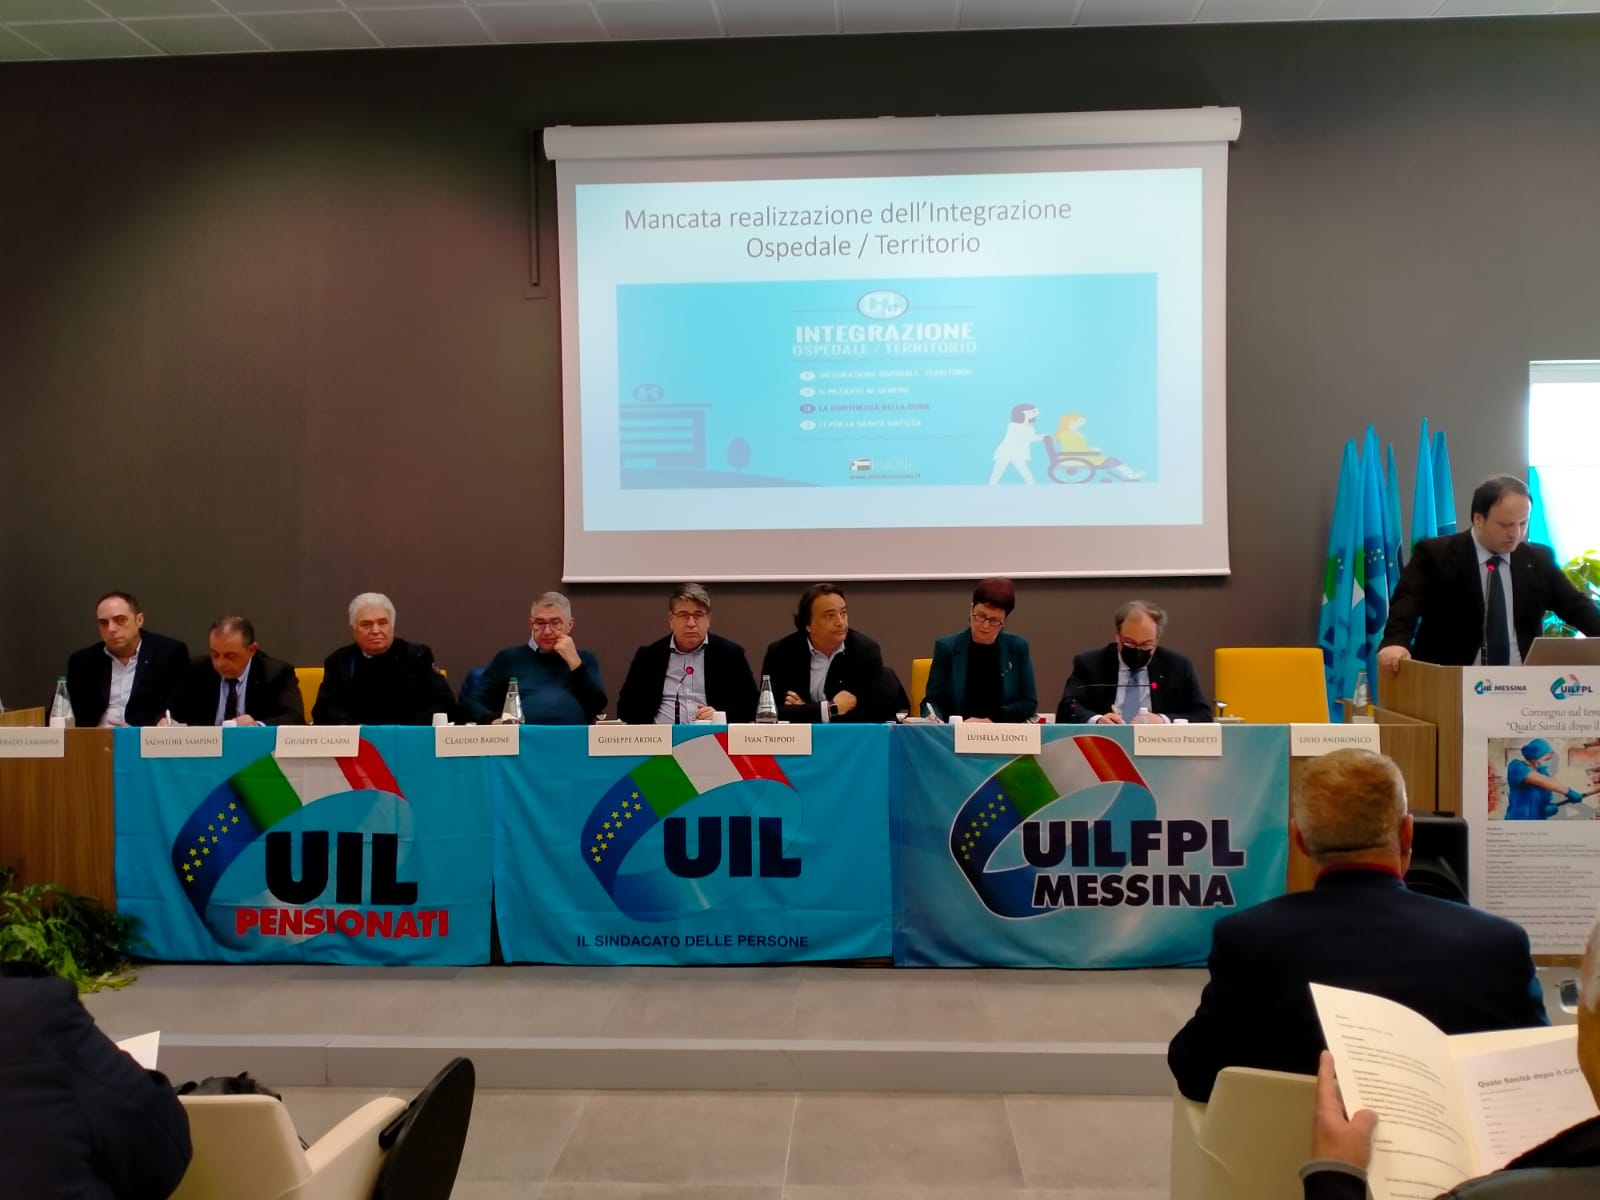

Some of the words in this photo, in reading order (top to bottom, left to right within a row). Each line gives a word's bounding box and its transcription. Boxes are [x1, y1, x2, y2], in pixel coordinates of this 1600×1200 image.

[624, 208, 721, 230] Mancata
[729, 205, 873, 228] realizzazione
[746, 235, 851, 262] Ospedale
[857, 232, 869, 259] /
[874, 232, 981, 255] Territorio
[795, 322, 975, 343] INTEGRAZIONE
[792, 343, 866, 356] OSPEDALE
[885, 340, 977, 353] TERRITORIO
[1560, 685, 1593, 693] UILFPL
[1520, 706, 1567, 720] Convegno
[1568, 705, 1581, 717] sul
[1538, 720, 1567, 731] Sanità
[1568, 720, 1592, 733] dopo
[145, 737, 182, 746] SALVATORE
[444, 736, 479, 745] CLAUDIO
[480, 736, 510, 744] BARONE
[598, 736, 632, 744] GIUSEPPE
[633, 736, 663, 744] ARDICA
[744, 735, 762, 743] IVAN
[763, 735, 795, 743] TRIPODI
[967, 733, 1000, 742] LUISELLA
[1001, 733, 1028, 742] LIONTI
[1137, 735, 1182, 744] DOMENICO
[1299, 735, 1321, 744] LIVIO
[663, 815, 802, 879] UIL
[1022, 819, 1246, 868] UILFPL
[265, 830, 418, 905] UIL
[1032, 873, 1237, 908] MESSINA
[235, 907, 449, 939] PENSIONATI
[577, 935, 591, 948] IL
[594, 934, 681, 948] SINDACATO
[685, 934, 734, 948] DELLE
[737, 934, 809, 948] PERSONE
[1477, 1079, 1502, 1089] Quale
[1503, 1074, 1532, 1085] Sanità
[1532, 1072, 1554, 1083] dopo
